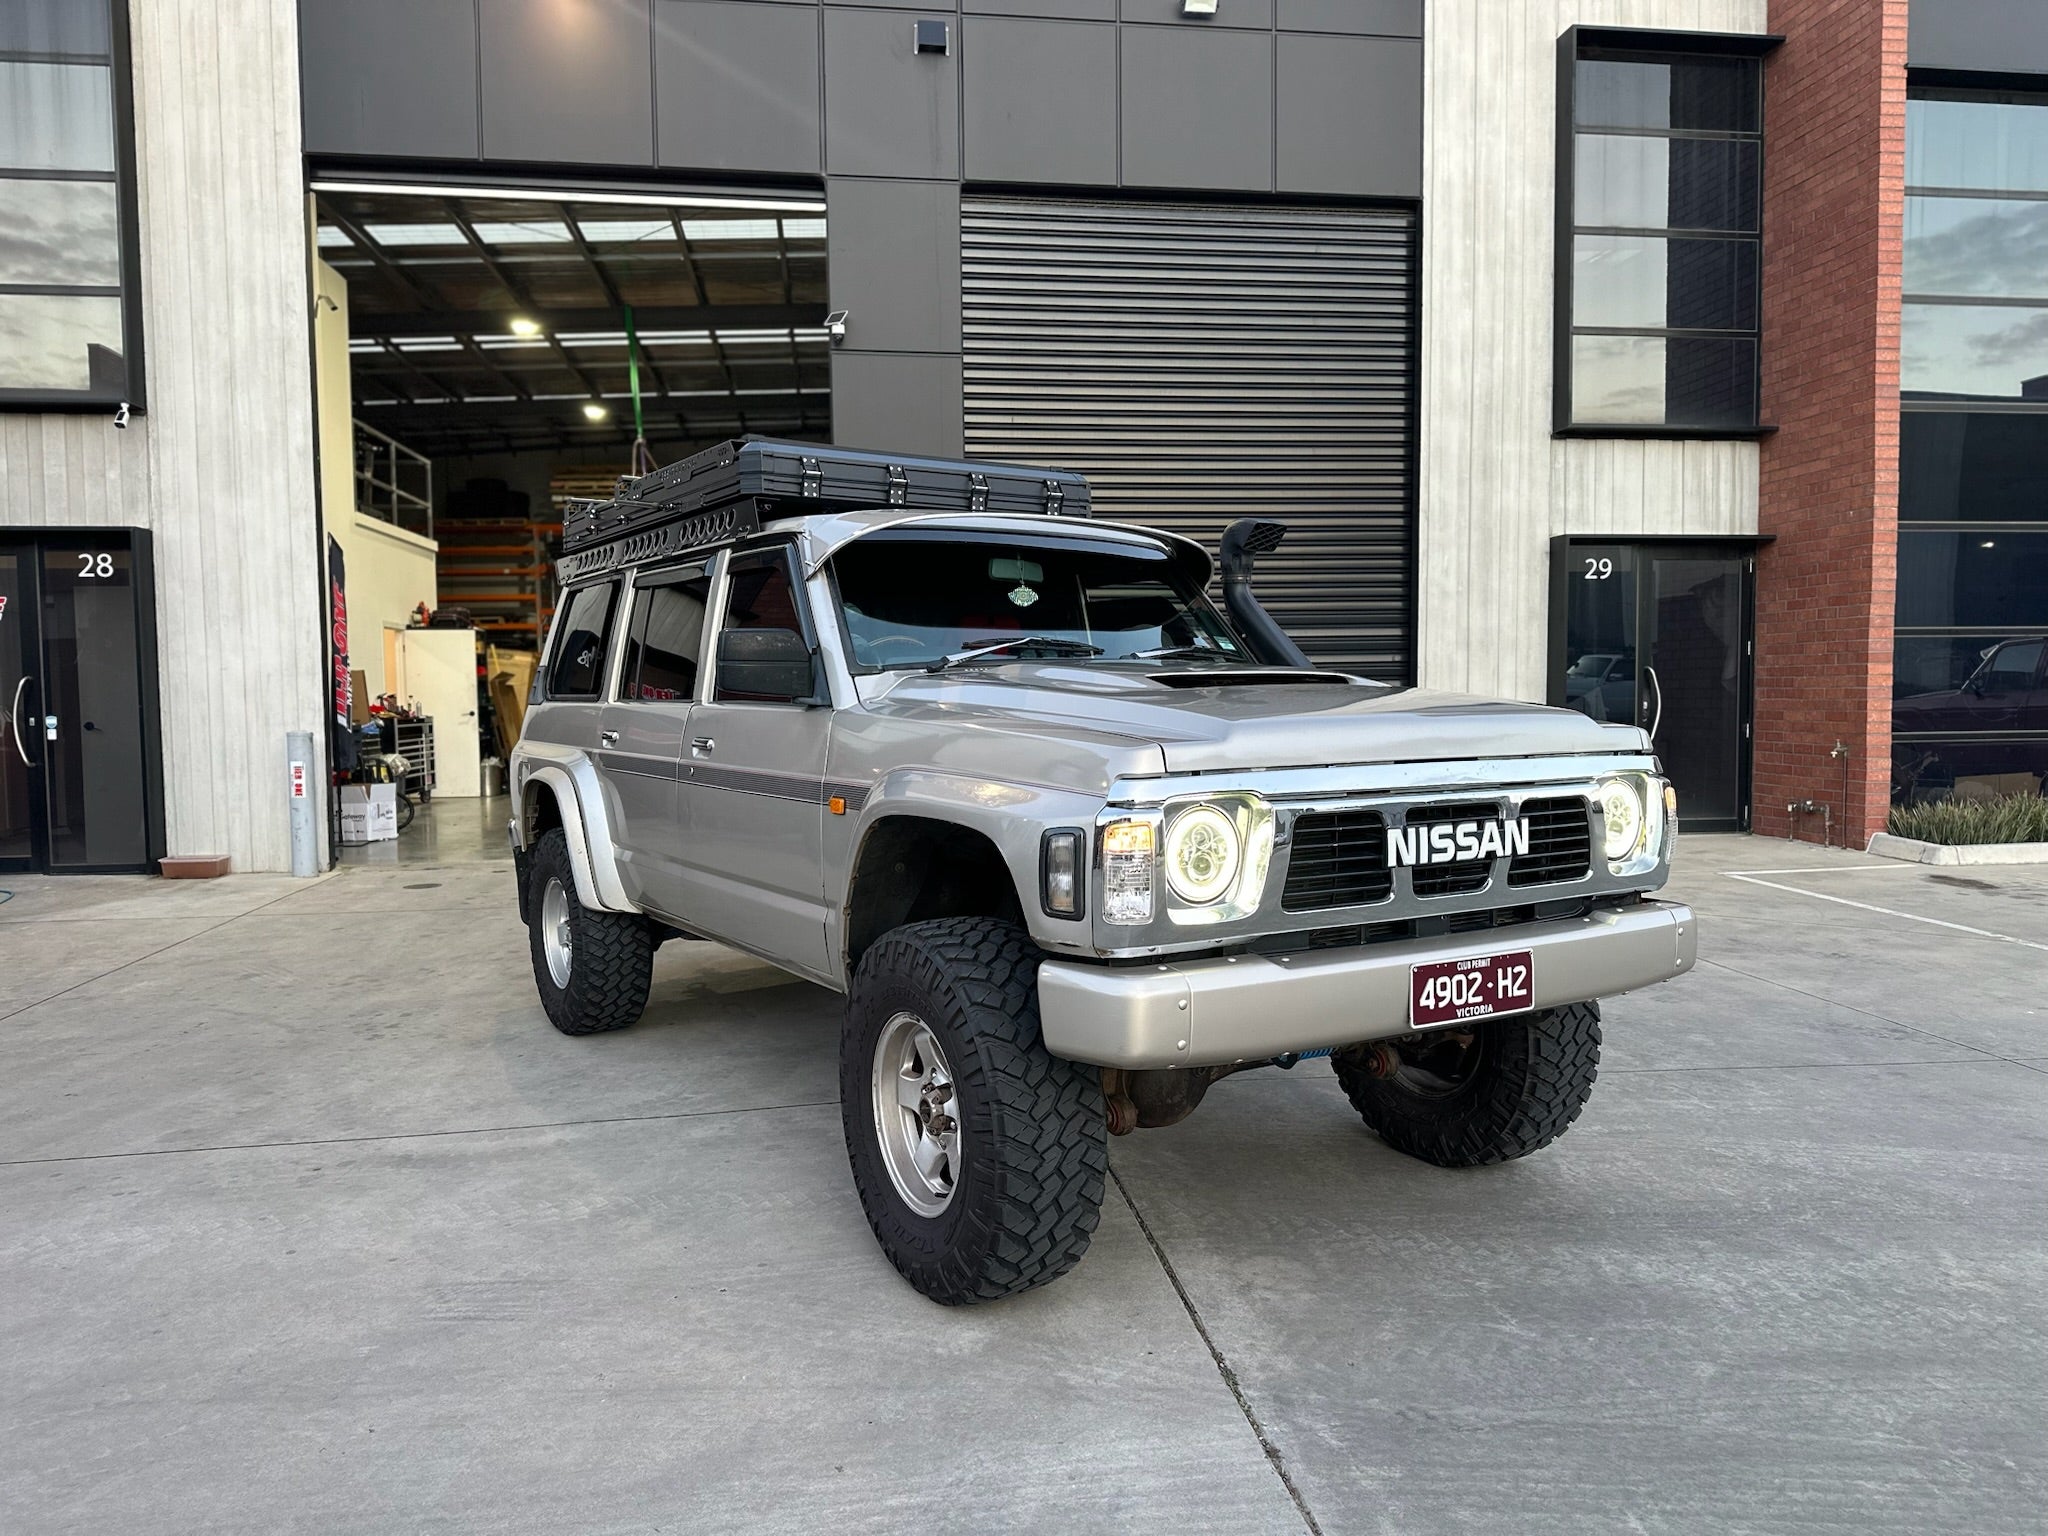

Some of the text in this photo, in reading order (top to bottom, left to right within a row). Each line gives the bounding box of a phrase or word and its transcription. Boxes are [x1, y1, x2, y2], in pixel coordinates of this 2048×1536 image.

[77, 553, 114, 578] 28
[1584, 558, 1613, 580] 29
[294, 783, 303, 797] ONE
[1387, 818, 1530, 867] NISSAN
[1456, 958, 1492, 971] CLUB PERMIT
[1456, 1004, 1493, 1018] VICTORIA
